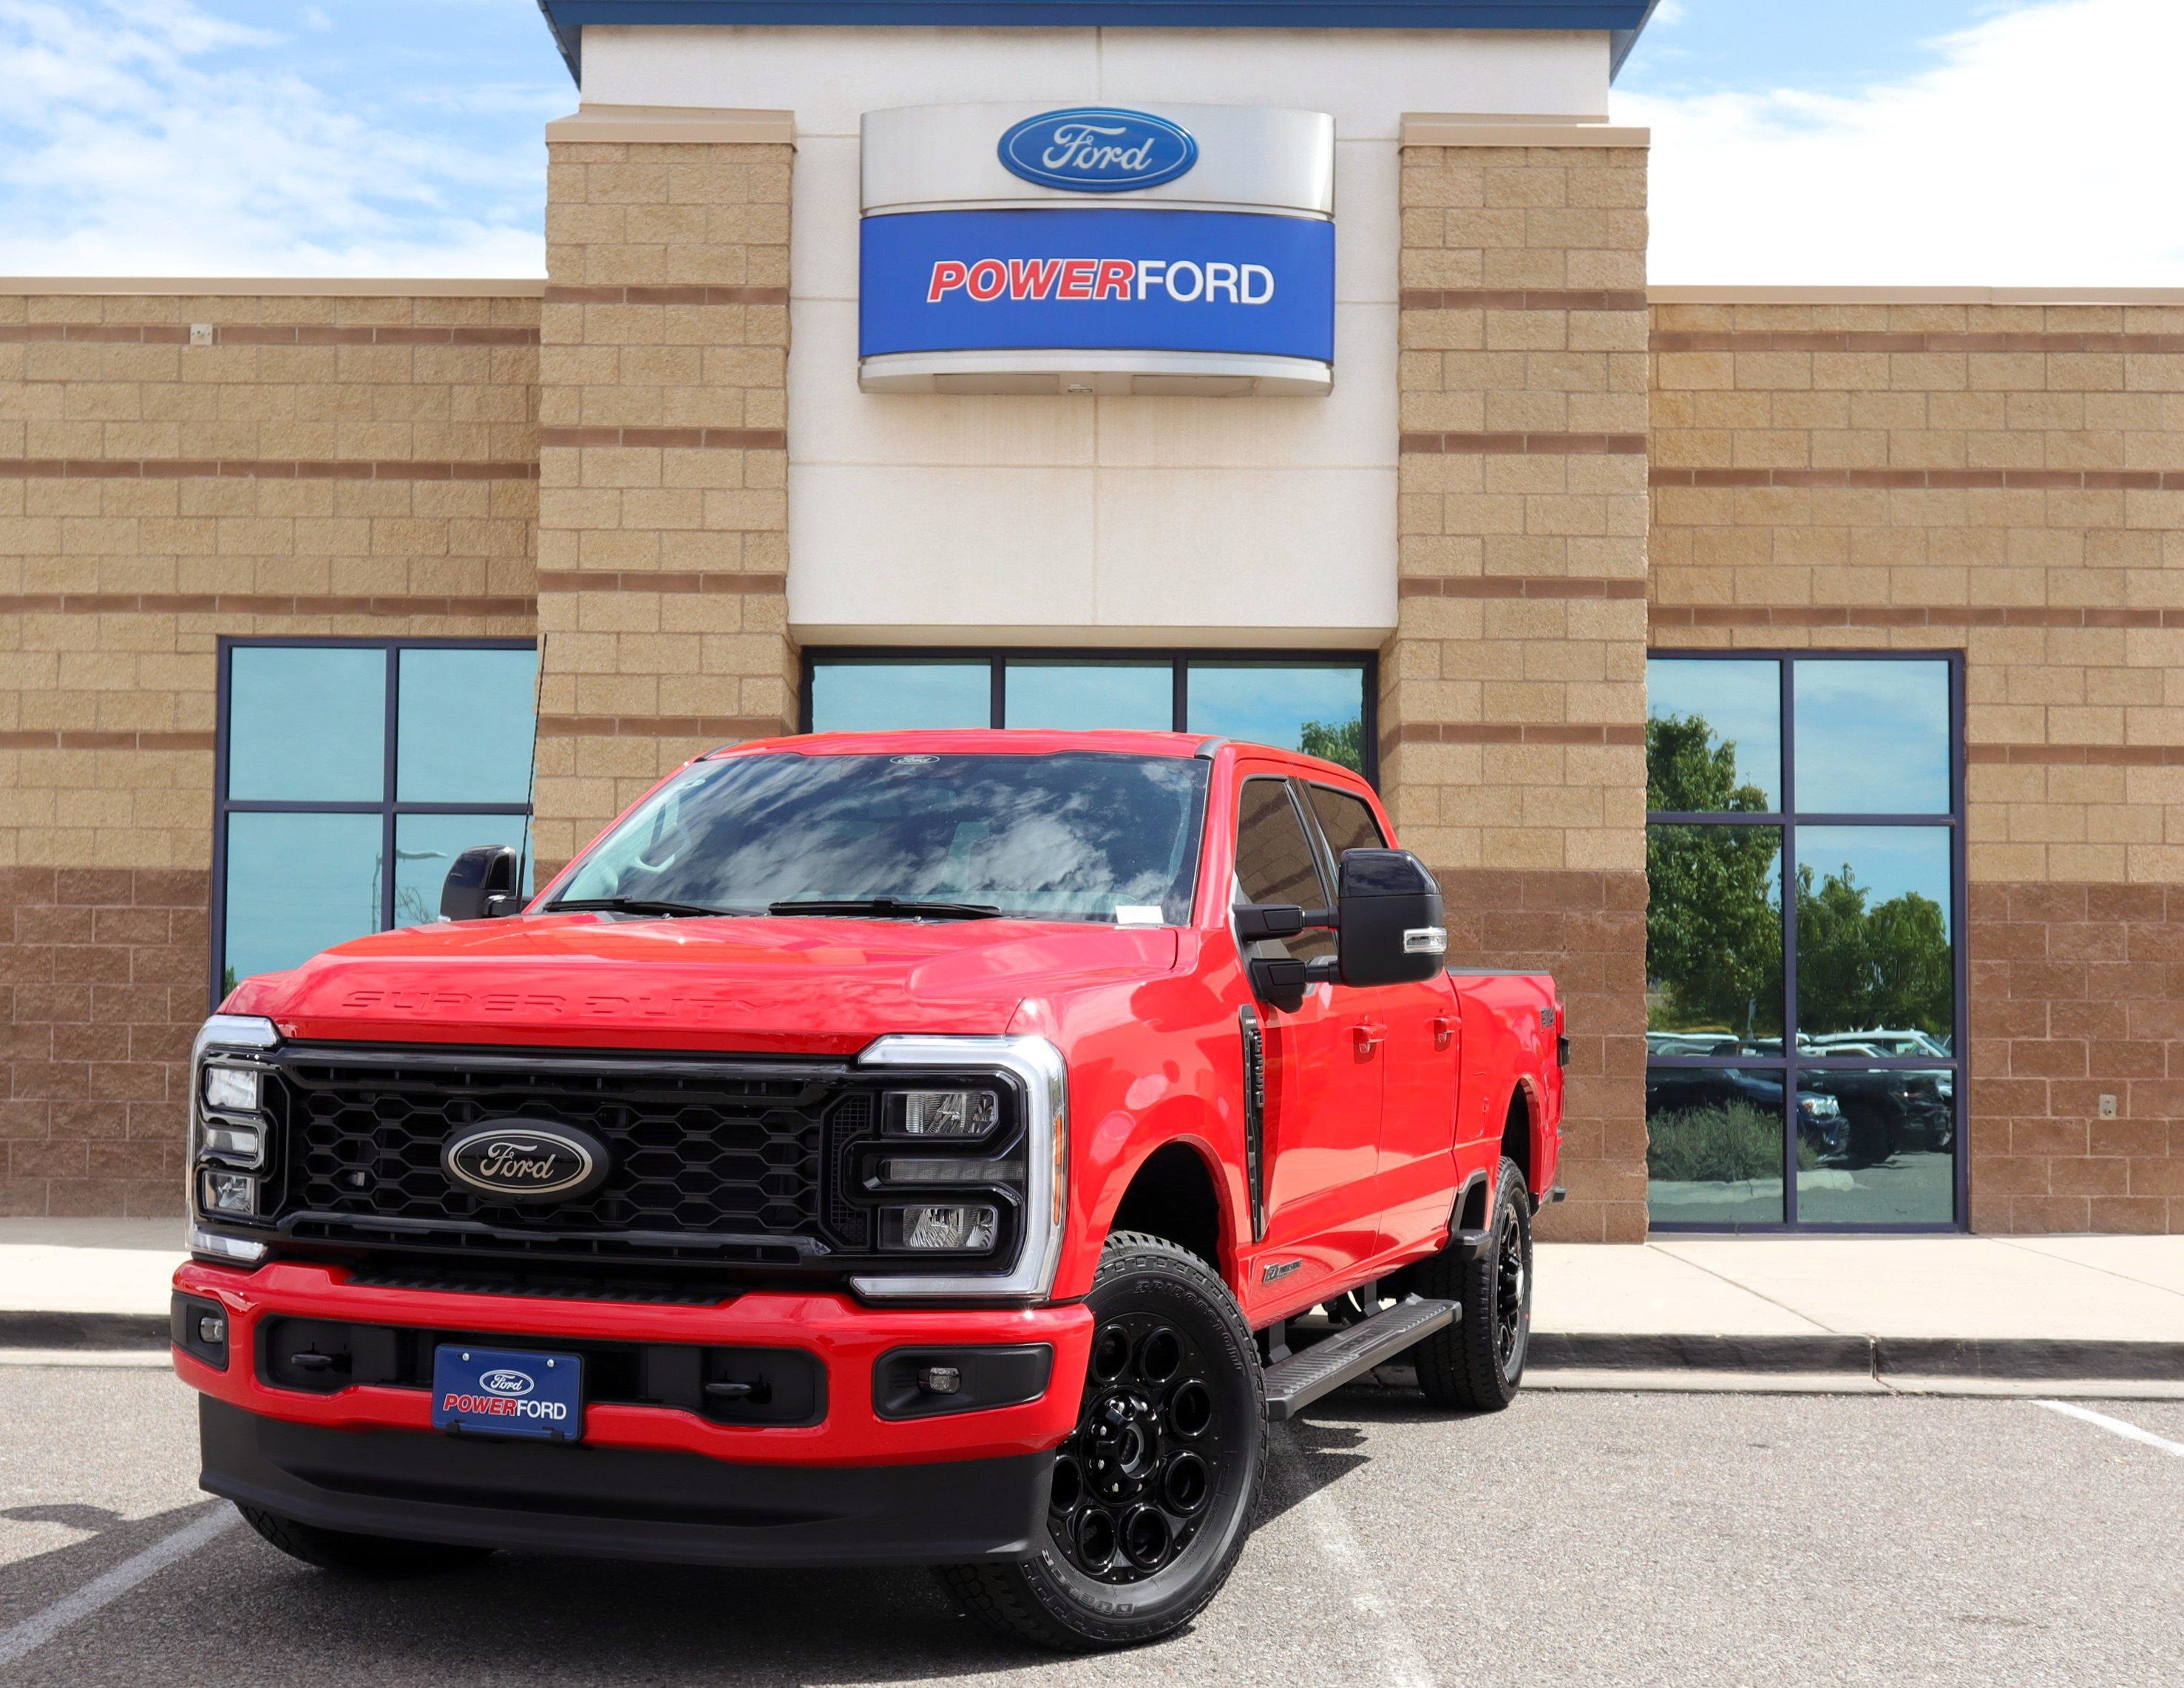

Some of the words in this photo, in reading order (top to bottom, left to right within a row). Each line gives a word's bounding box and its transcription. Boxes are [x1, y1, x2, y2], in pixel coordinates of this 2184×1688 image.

[1042, 123, 1154, 171] Ford
[342, 991, 567, 1014] SUPER
[580, 995, 783, 1020] DUTY
[480, 1142, 557, 1179] Ford
[489, 1374, 523, 1392] Ford
